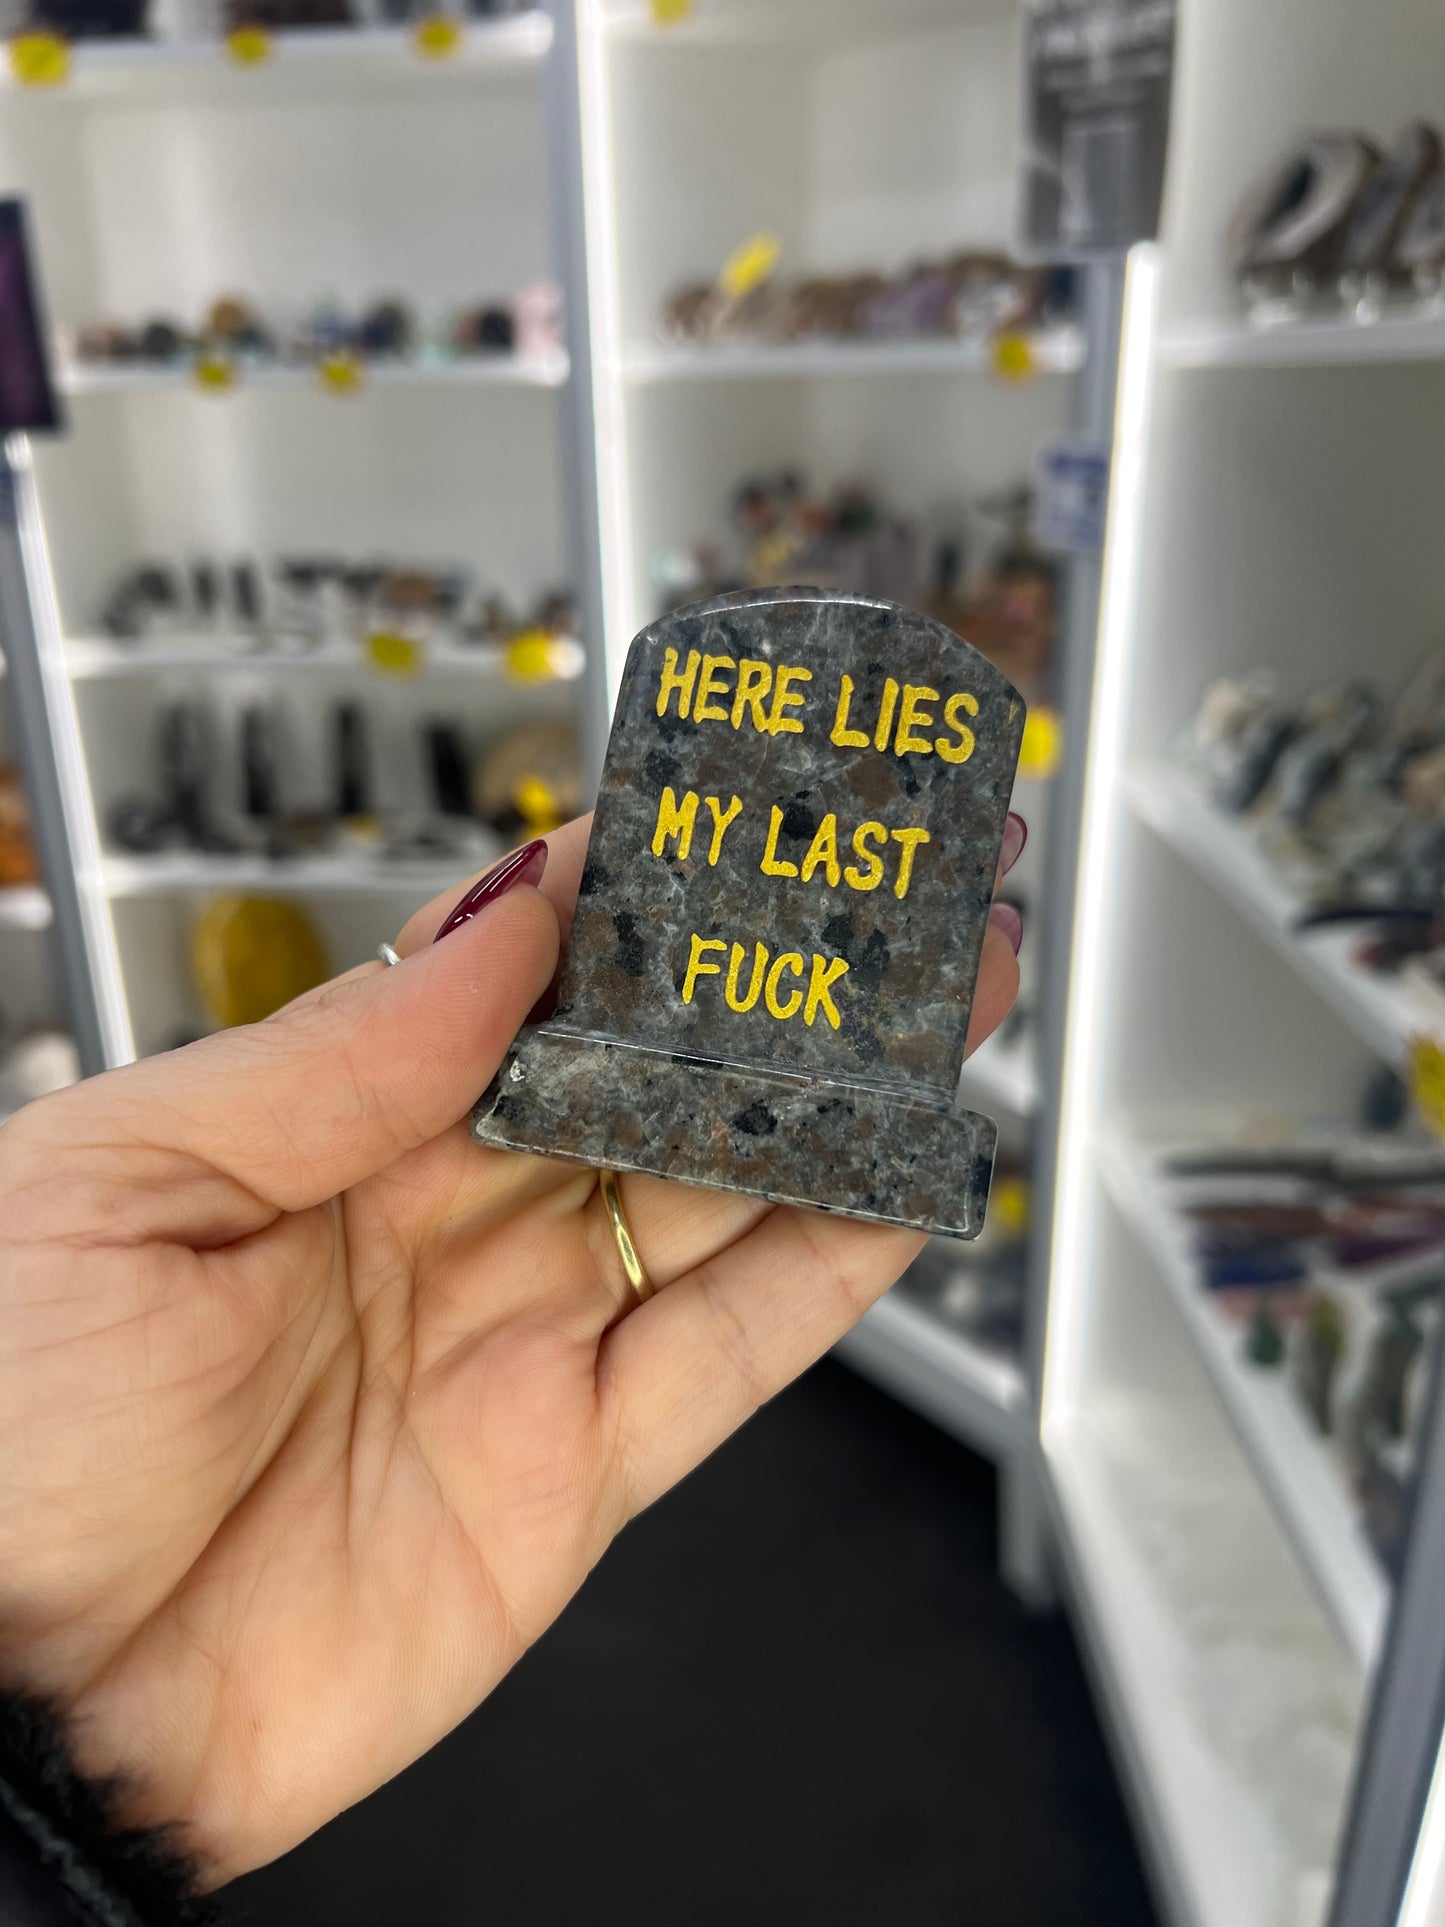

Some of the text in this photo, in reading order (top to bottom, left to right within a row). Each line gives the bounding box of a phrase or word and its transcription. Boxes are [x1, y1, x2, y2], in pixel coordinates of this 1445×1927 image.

[656, 647, 980, 763] HERE LIES
[651, 786, 931, 900] MY LAST
[681, 933, 849, 1031] FUCK
